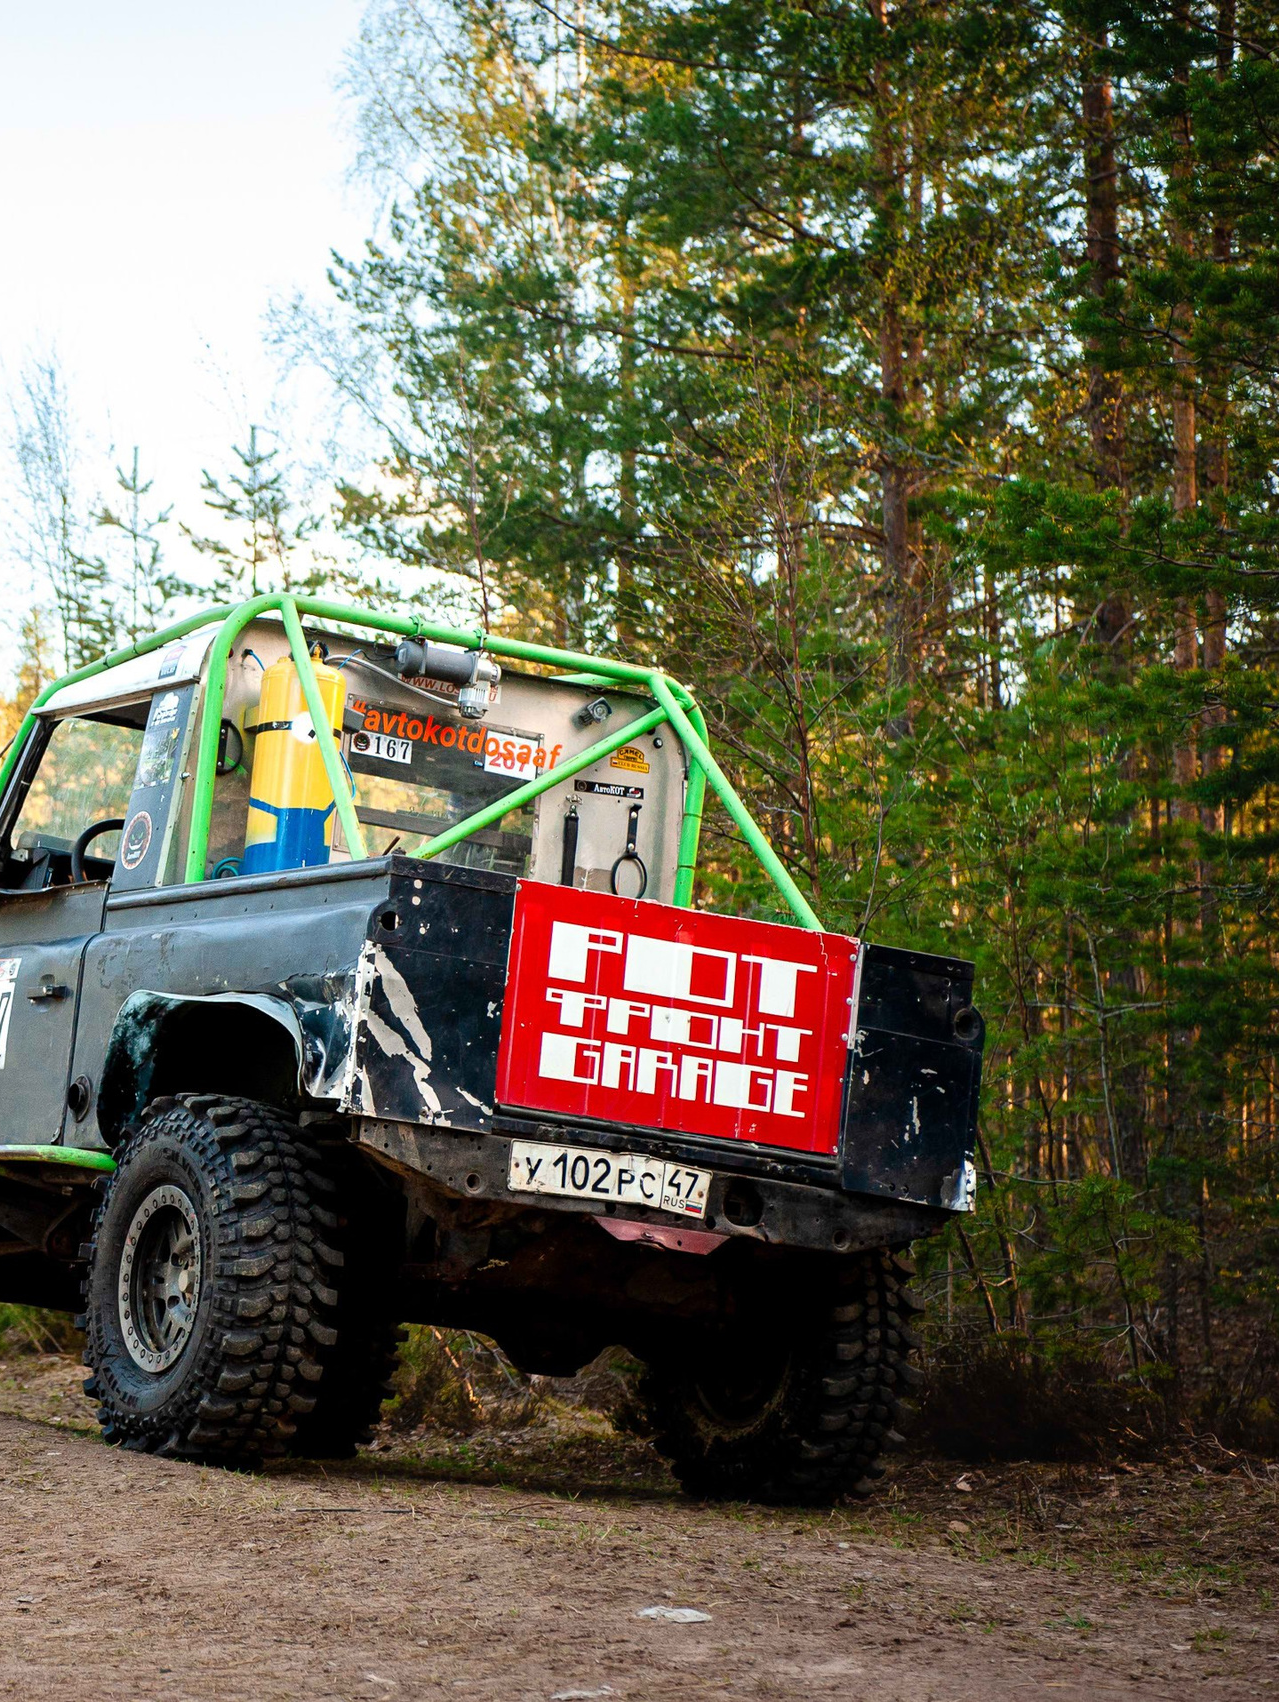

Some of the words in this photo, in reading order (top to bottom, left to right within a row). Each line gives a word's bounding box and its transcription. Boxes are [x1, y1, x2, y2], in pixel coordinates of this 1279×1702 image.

[375, 736, 410, 760] 167
[538, 1031, 809, 1118] GARAGE
[668, 1168, 699, 1199] 47
[663, 1195, 685, 1209] RUS
